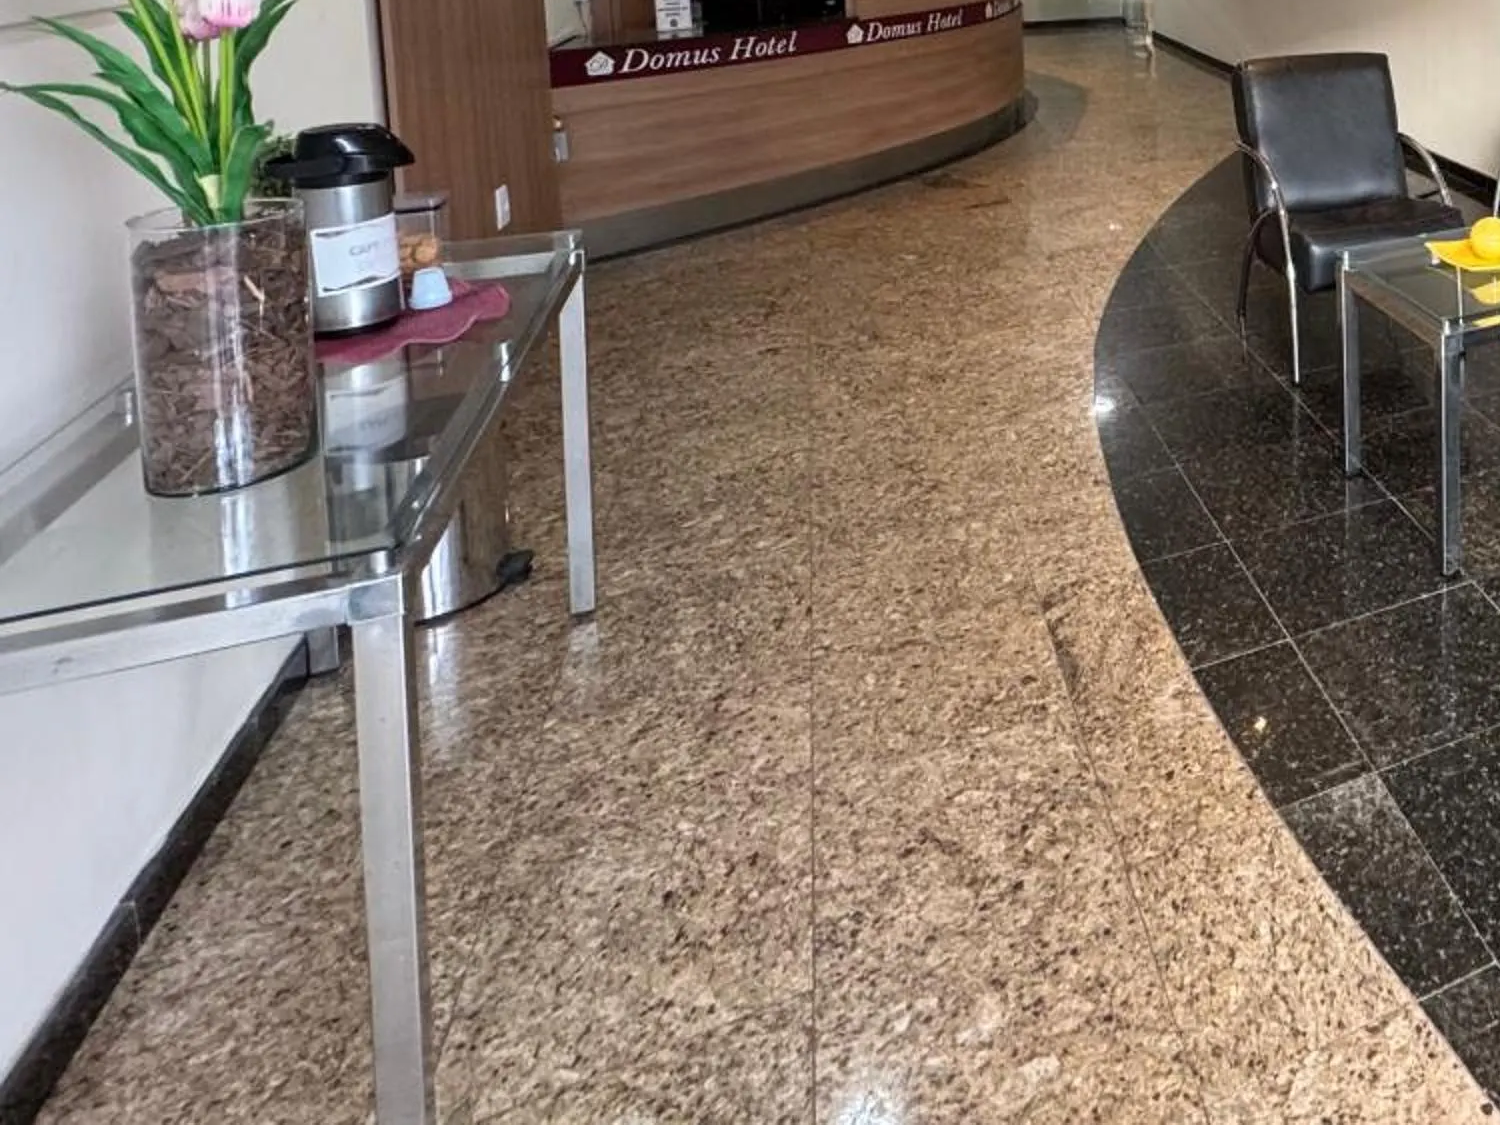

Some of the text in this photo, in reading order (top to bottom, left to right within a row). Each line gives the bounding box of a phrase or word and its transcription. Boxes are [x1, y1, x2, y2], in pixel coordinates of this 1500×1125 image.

[866, 8, 963, 42] Domus Hotel
[617, 46, 722, 74] Domus
[729, 30, 798, 61] Hotel
